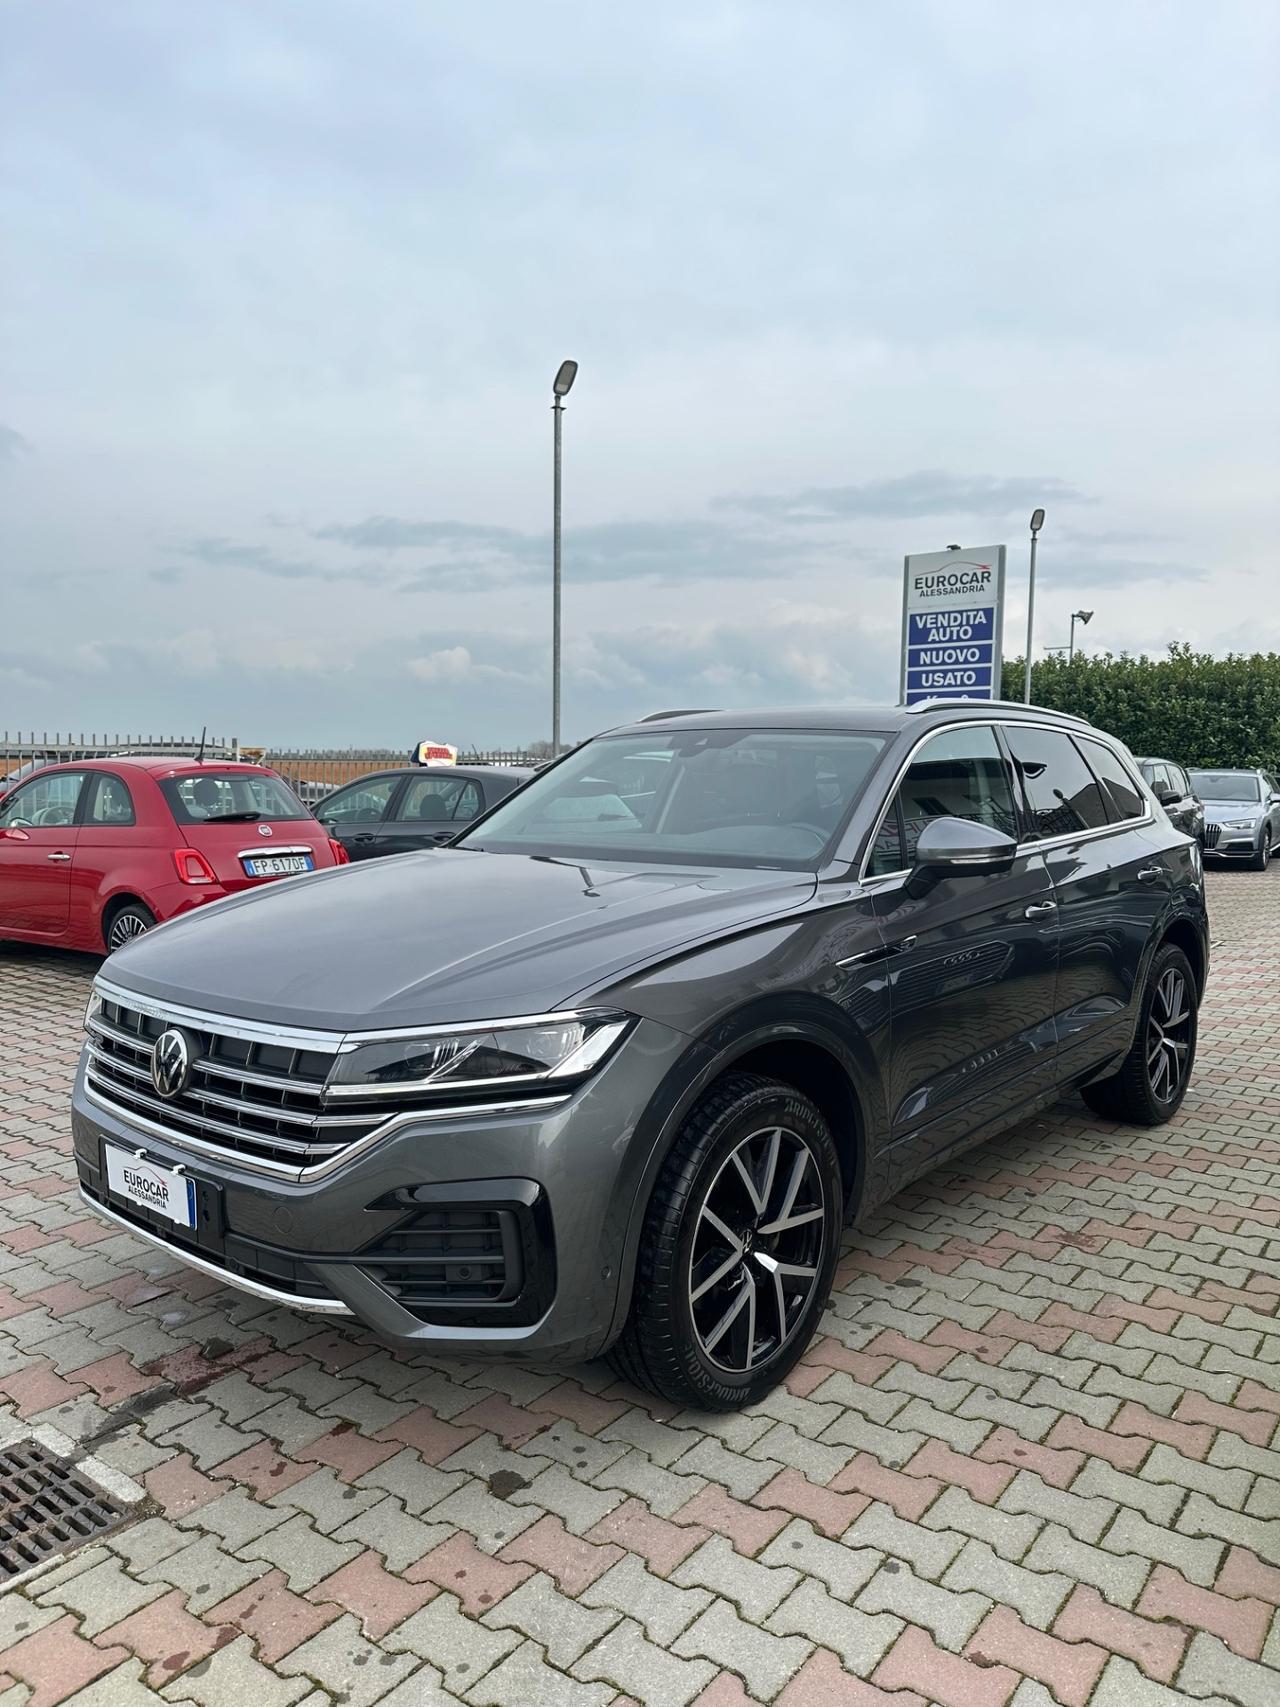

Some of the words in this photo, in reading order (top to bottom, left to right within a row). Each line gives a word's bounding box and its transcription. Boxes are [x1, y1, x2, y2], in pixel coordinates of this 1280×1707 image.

[915, 571, 991, 589] EUROCAR
[919, 585, 985, 598] ALESSANDRIA
[915, 610, 986, 629] VENDITA
[928, 626, 972, 642] AUTO
[920, 648, 980, 665] NUOVO
[921, 671, 976, 687] USATO
[123, 1169, 169, 1202] EUROCAR
[128, 1185, 167, 1209] ALESSANDRIA
